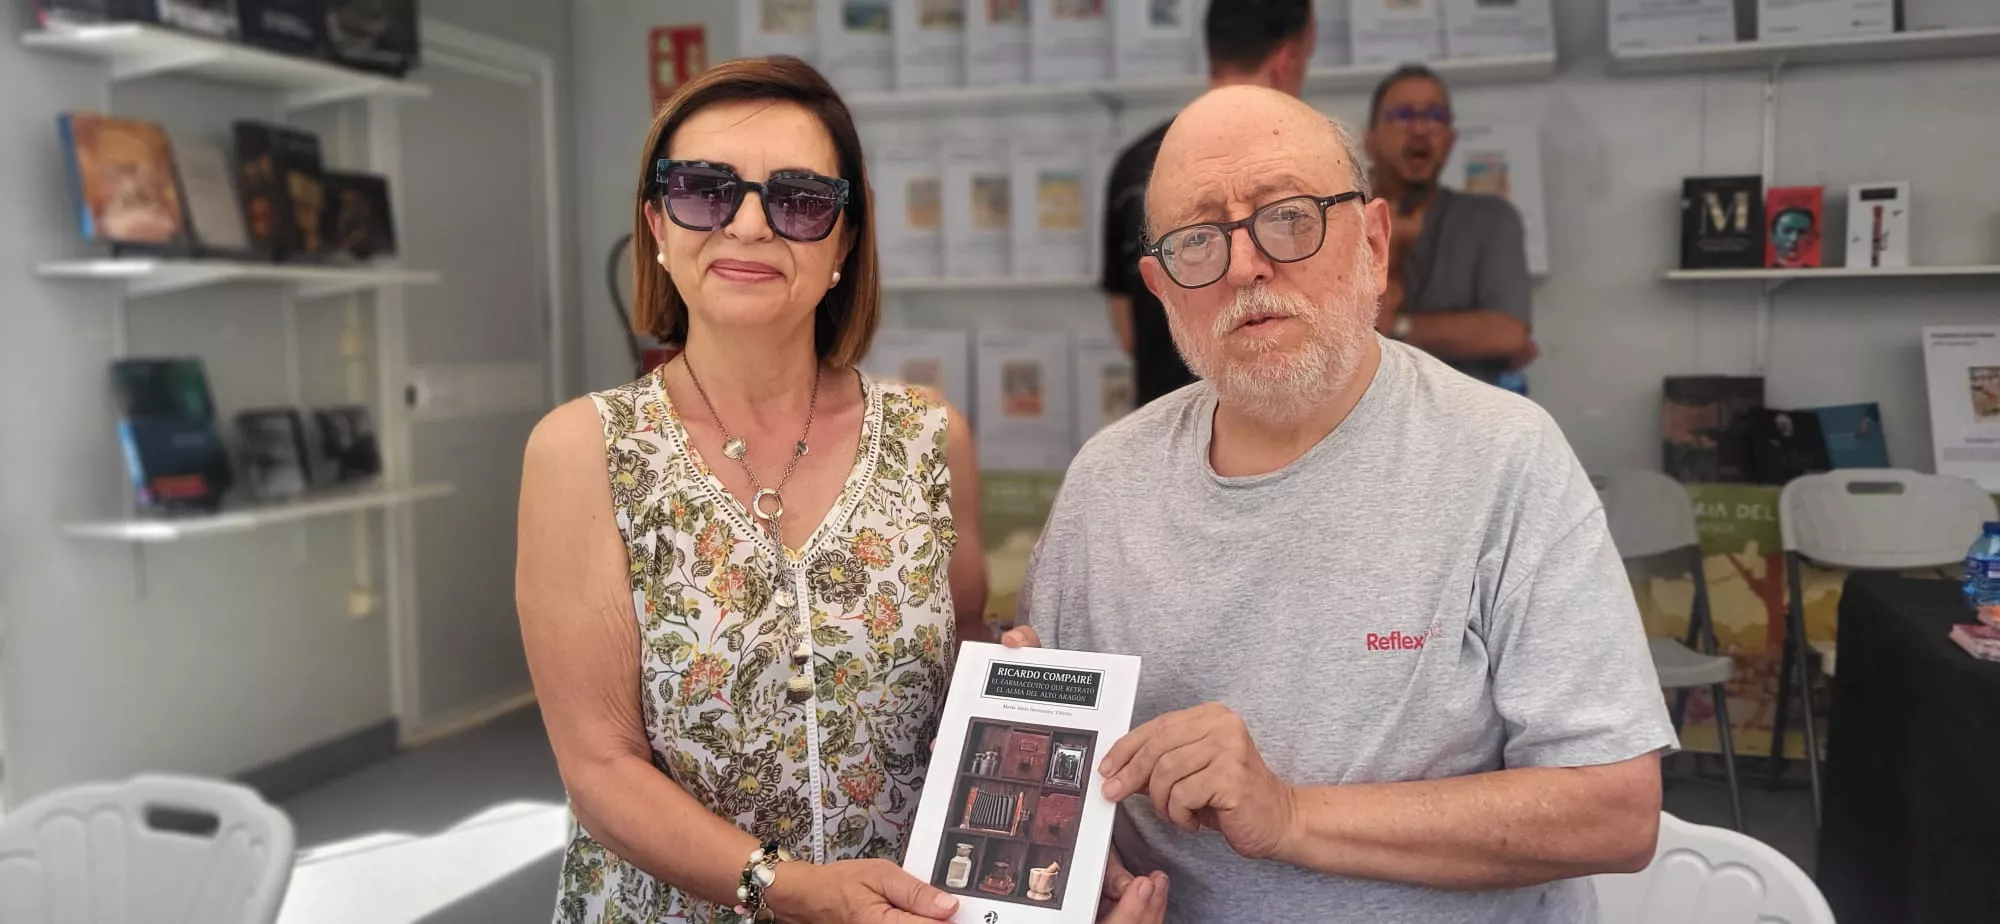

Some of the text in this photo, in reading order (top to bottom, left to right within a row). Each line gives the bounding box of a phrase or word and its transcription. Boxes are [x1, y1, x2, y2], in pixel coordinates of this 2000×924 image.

[1736, 504, 1777, 521] DEL
[997, 667, 1094, 685] RICARDO COMPAIRÉ
[1000, 678, 1050, 690] FARMACÉUTICO
[1050, 684, 1064, 692] QUE
[1005, 687, 1025, 696] ALMA
[1026, 689, 1038, 697] DEL
[1058, 693, 1087, 702] ARAGÓN
